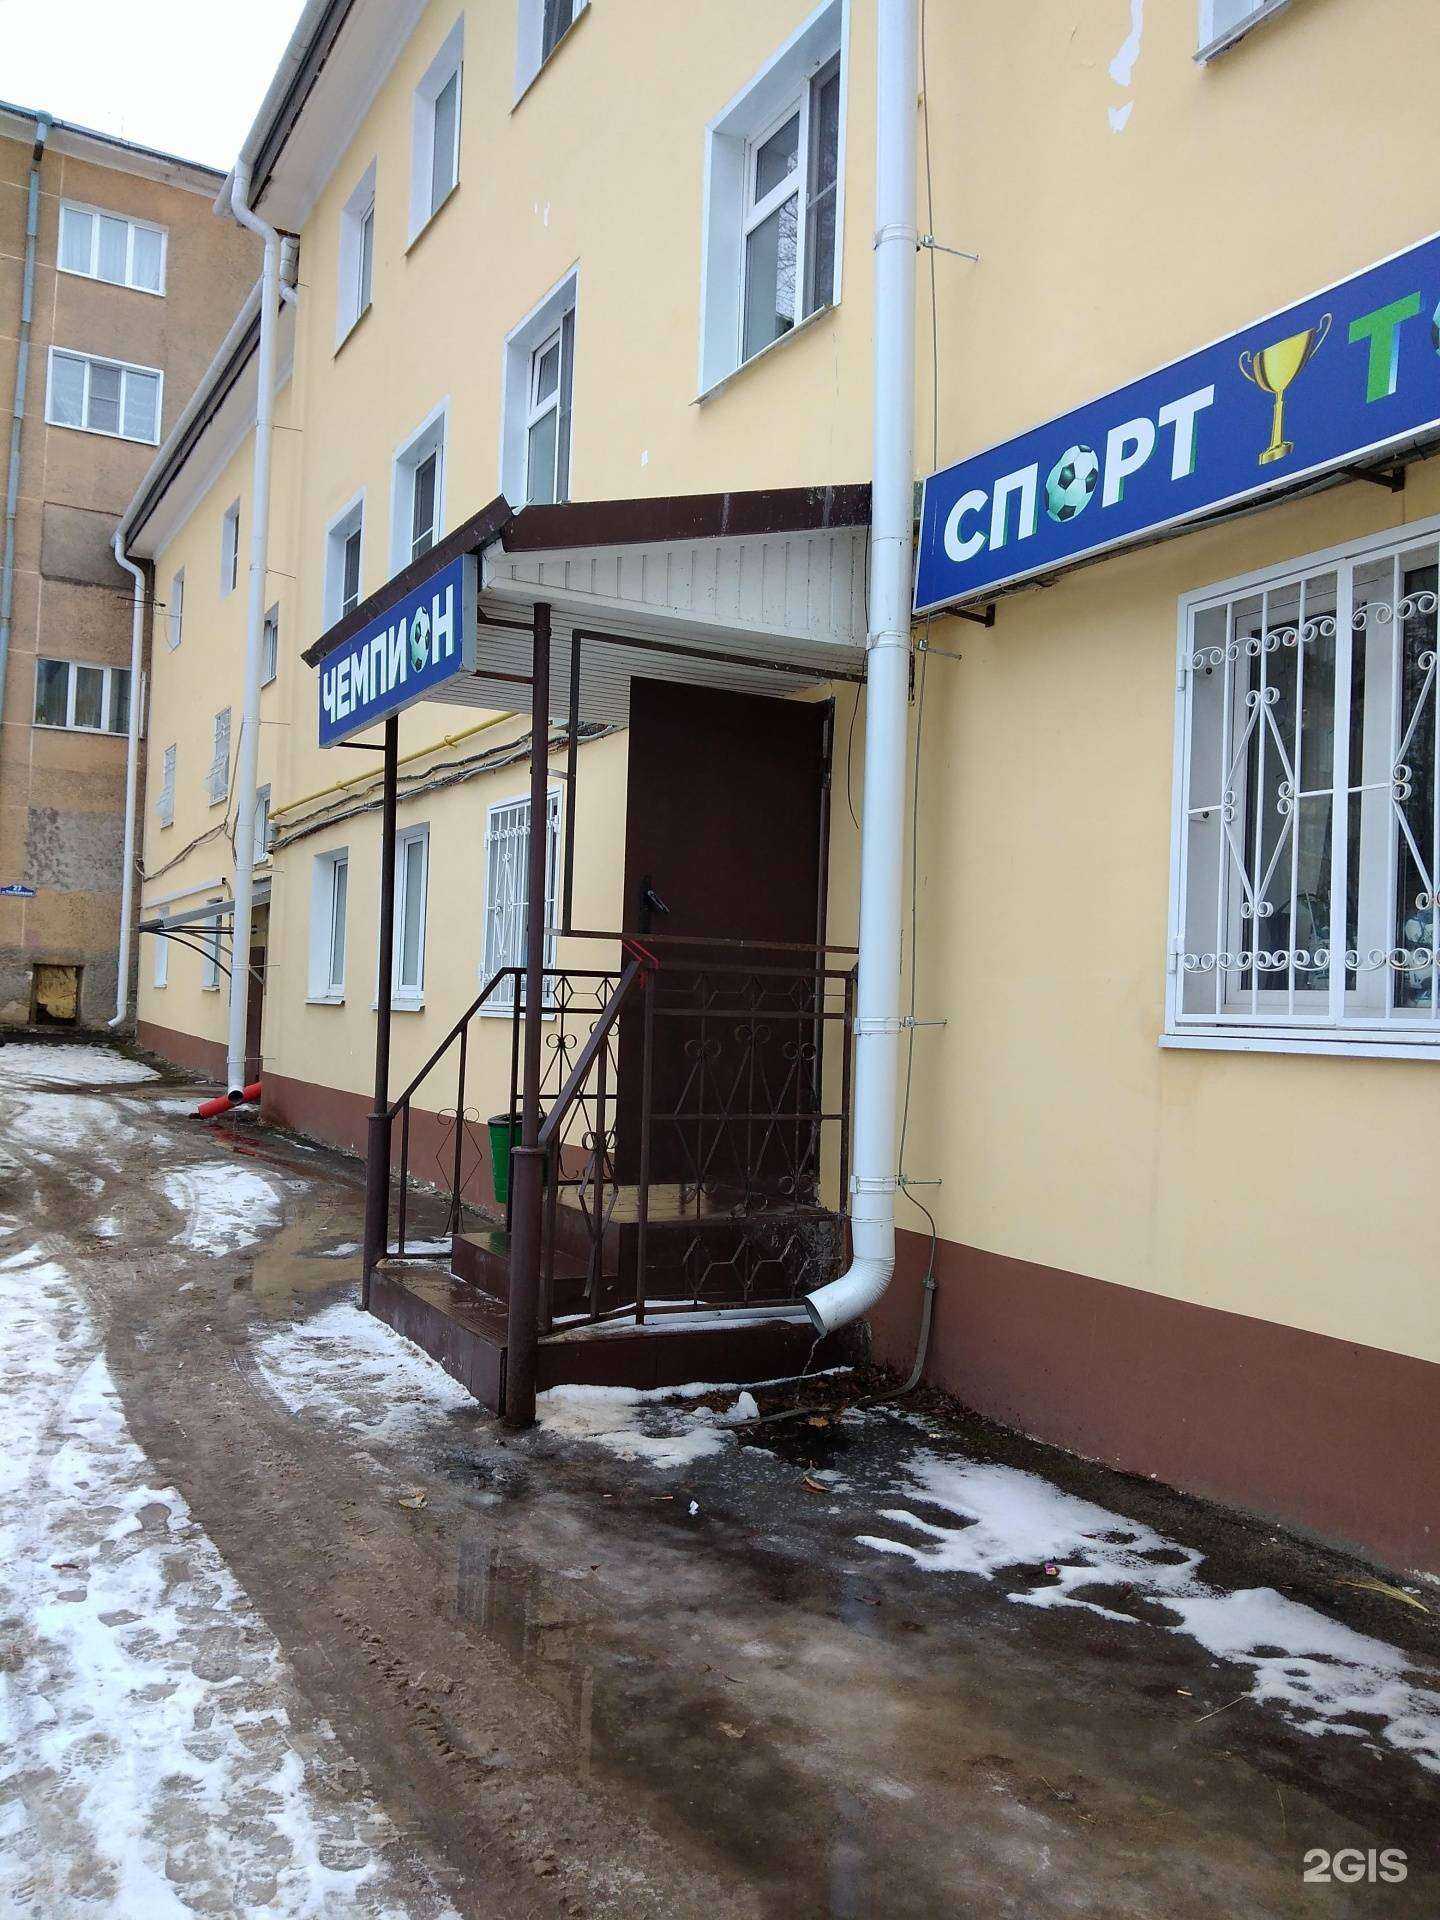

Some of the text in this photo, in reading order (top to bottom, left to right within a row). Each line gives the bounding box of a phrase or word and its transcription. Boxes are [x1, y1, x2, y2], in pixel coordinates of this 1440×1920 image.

[944, 290, 1440, 562] СПОРТ Т
[323, 583, 455, 723] ЧЕМПИОН
